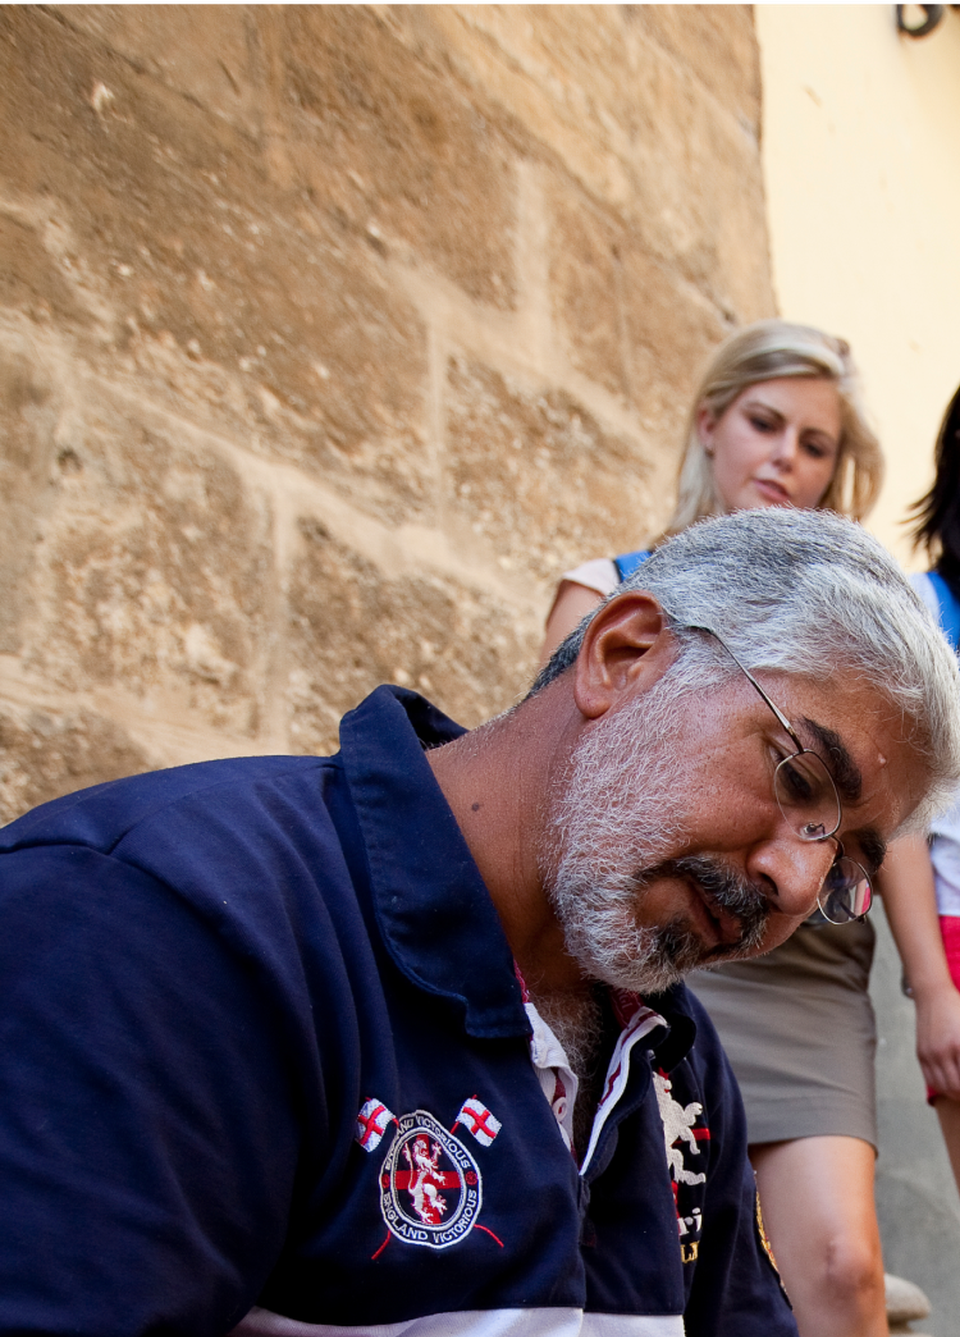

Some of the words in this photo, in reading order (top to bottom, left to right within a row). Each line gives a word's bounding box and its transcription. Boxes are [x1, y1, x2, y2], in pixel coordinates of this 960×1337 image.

[416, 1115, 471, 1169] VICTORIOUS
[382, 1191, 428, 1241] ENGLAND
[433, 1189, 477, 1243] VICTORIOUS
